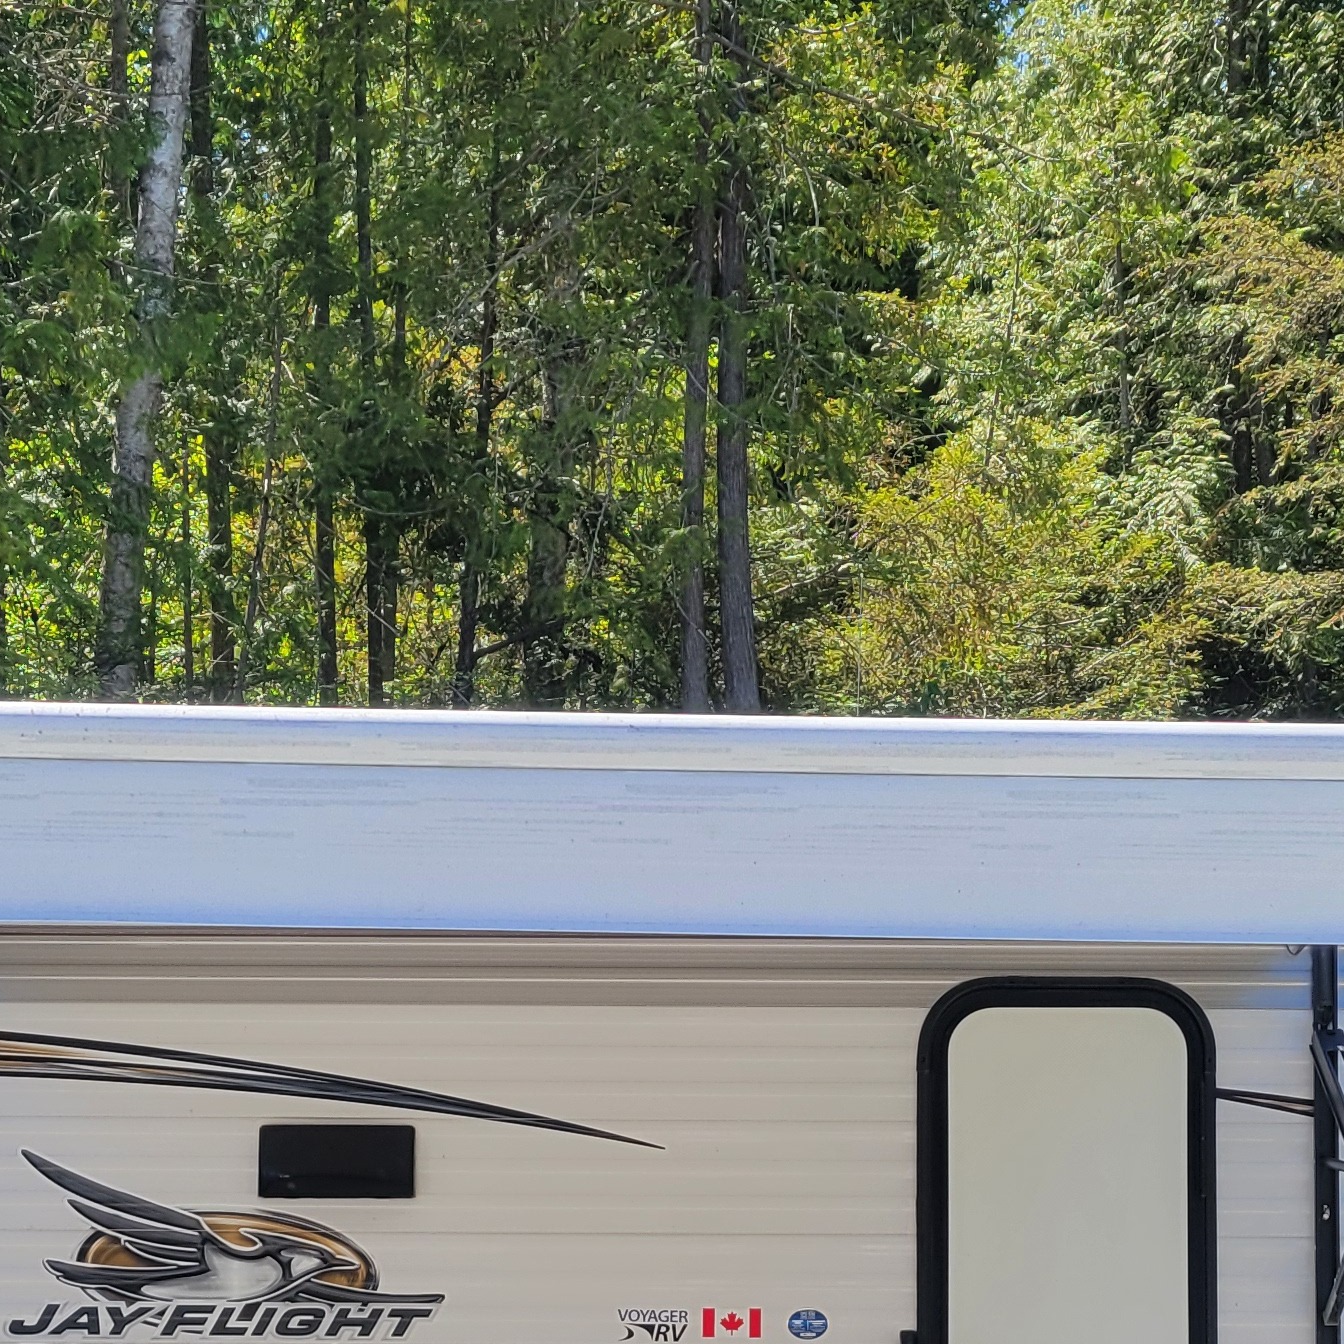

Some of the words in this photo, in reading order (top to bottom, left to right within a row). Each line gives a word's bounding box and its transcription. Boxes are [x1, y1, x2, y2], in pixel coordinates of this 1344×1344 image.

[8, 1303, 156, 1335] JAY
[160, 1304, 434, 1337] FLIGHT
[617, 1308, 689, 1323] VOYAGER
[654, 1323, 688, 1342] RV
